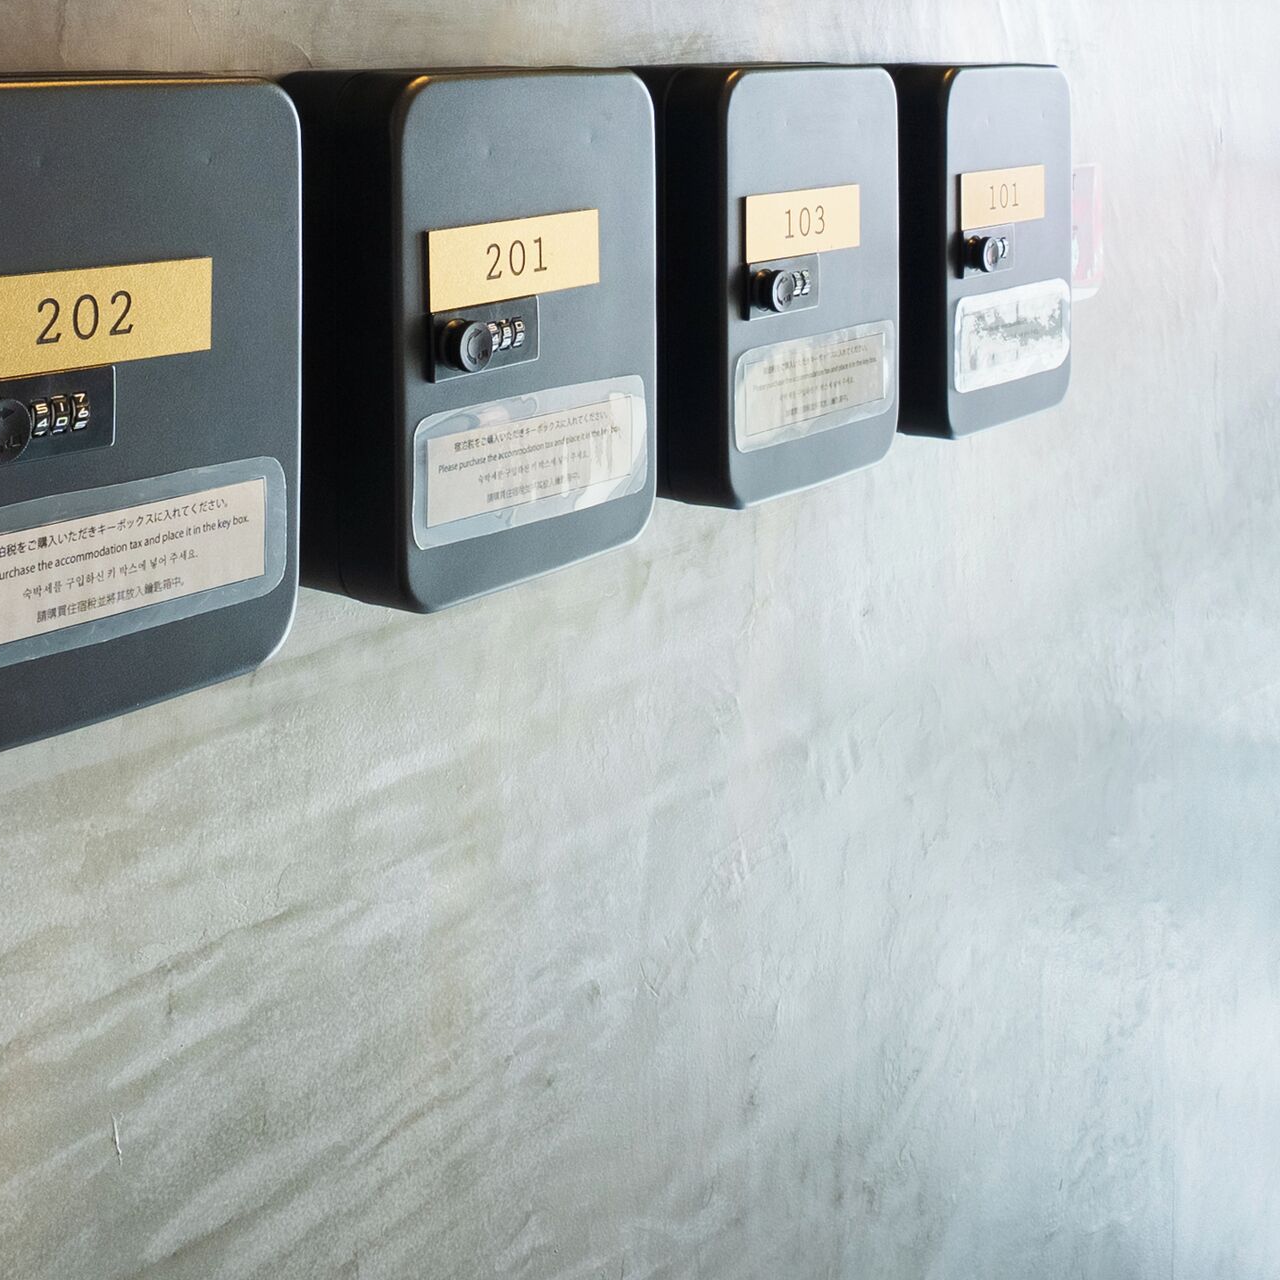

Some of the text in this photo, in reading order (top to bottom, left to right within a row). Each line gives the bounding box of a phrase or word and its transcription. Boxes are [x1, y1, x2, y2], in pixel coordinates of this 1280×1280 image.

[989, 182, 1019, 210] 101
[785, 205, 825, 239] 103
[487, 237, 547, 280] 201
[36, 291, 133, 345] 202
[37, 559, 54, 572] the
[54, 543, 128, 568] accommodation
[129, 539, 143, 551] tax
[143, 532, 161, 547] and
[161, 529, 185, 545] place
[185, 526, 192, 537] it
[192, 524, 201, 535] in
[202, 521, 217, 533] the
[217, 518, 232, 530] key
[232, 515, 250, 526] box.
